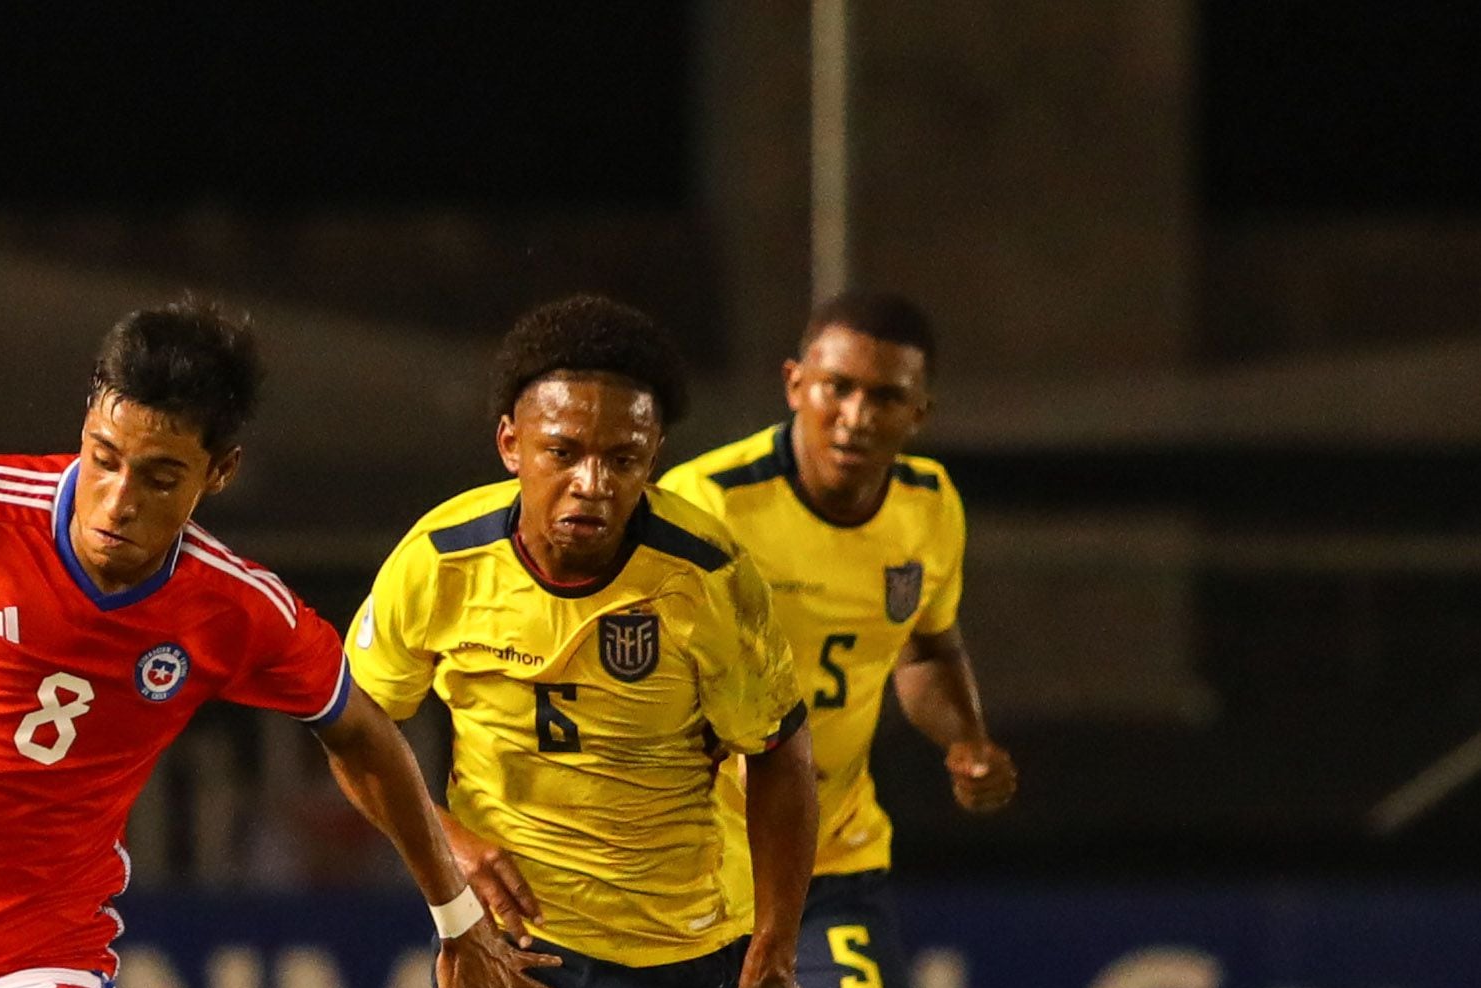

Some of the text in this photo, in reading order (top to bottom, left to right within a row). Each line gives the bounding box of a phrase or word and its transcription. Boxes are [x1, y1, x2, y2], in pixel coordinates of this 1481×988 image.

[457, 641, 544, 667] rathon
[814, 632, 857, 709] 5
[15, 671, 95, 766] 8
[533, 683, 581, 753] 6
